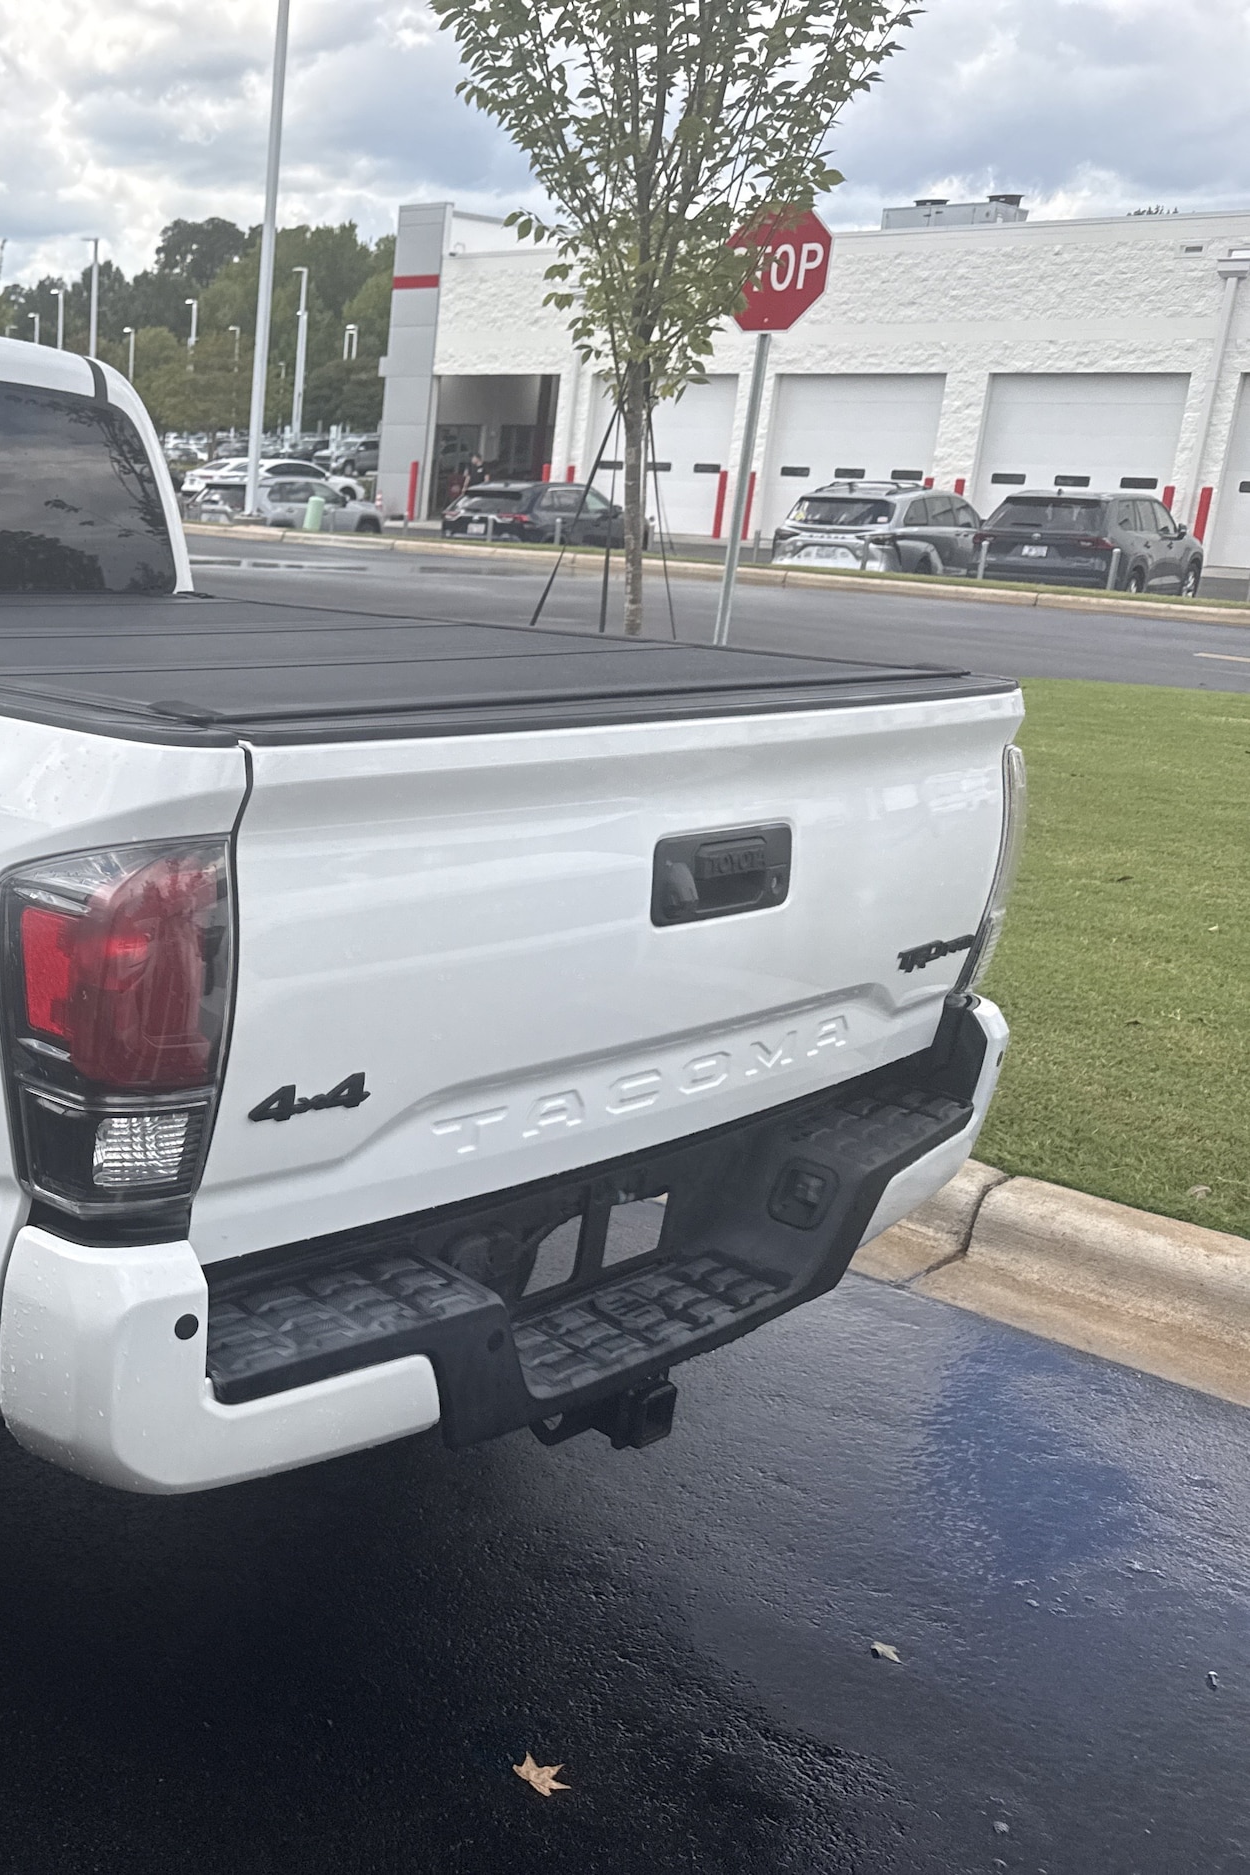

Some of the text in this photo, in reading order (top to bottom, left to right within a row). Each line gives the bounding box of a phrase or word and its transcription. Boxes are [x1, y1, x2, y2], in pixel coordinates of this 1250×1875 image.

[734, 242, 824, 292] TOP
[248, 1071, 371, 1122] 4x4
[432, 1015, 849, 1154] TACOMA
